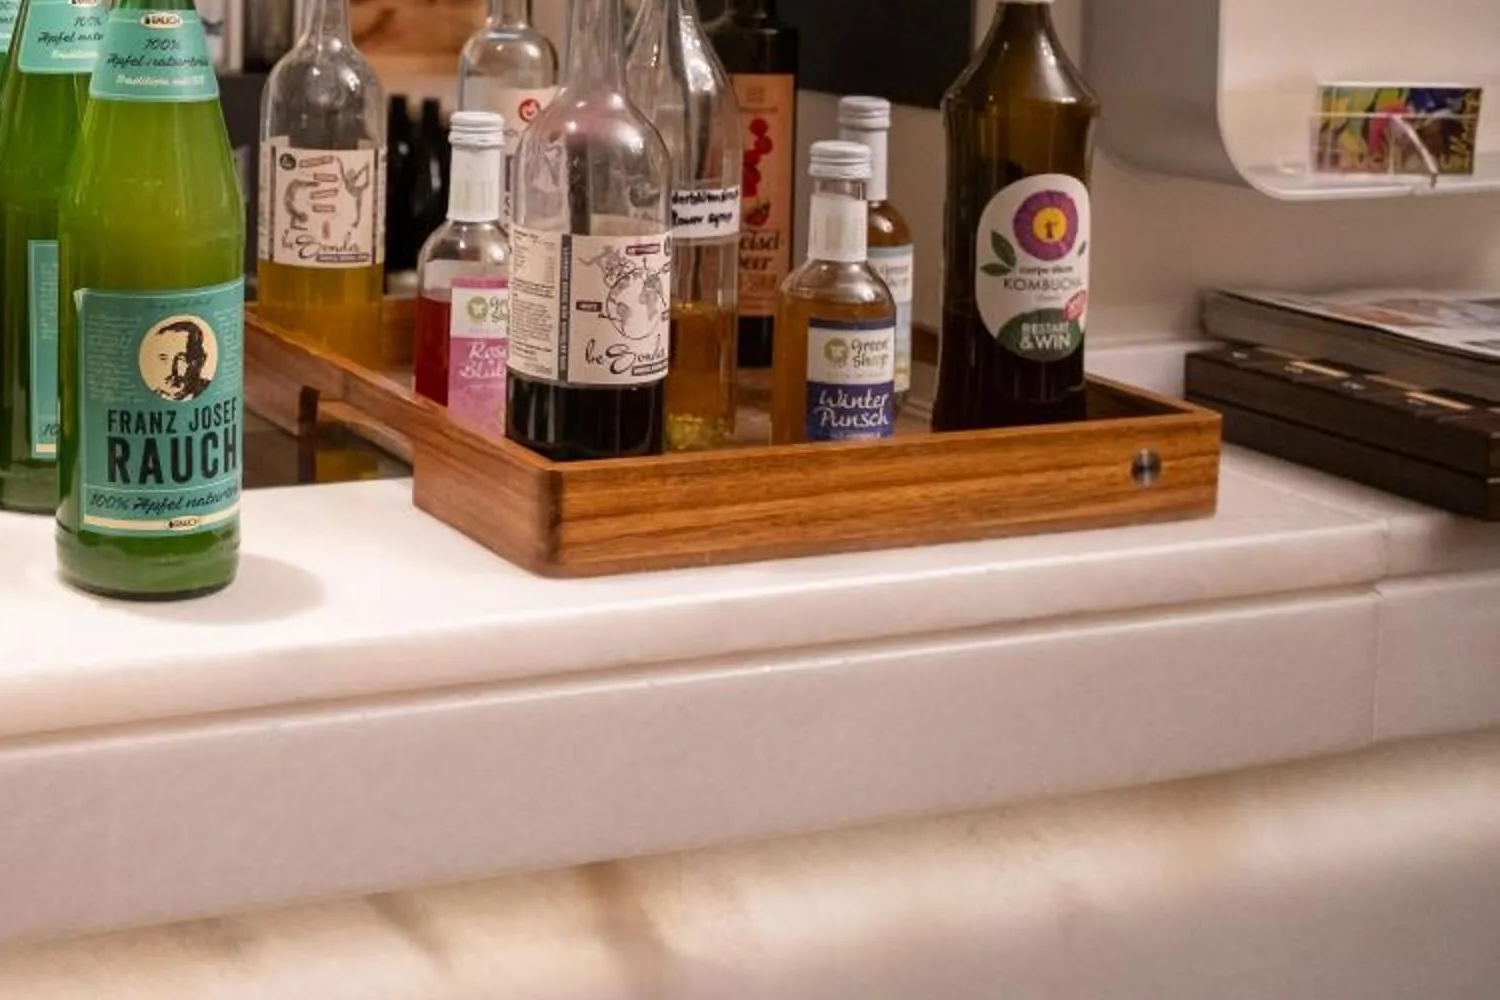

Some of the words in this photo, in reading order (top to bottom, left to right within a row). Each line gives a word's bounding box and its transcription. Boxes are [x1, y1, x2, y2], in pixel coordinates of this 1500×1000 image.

[107, 410, 178, 434] FRANZ
[189, 397, 237, 432] JOSEF
[107, 424, 238, 485] RAUCH
[132, 494, 184, 516] Apfel
